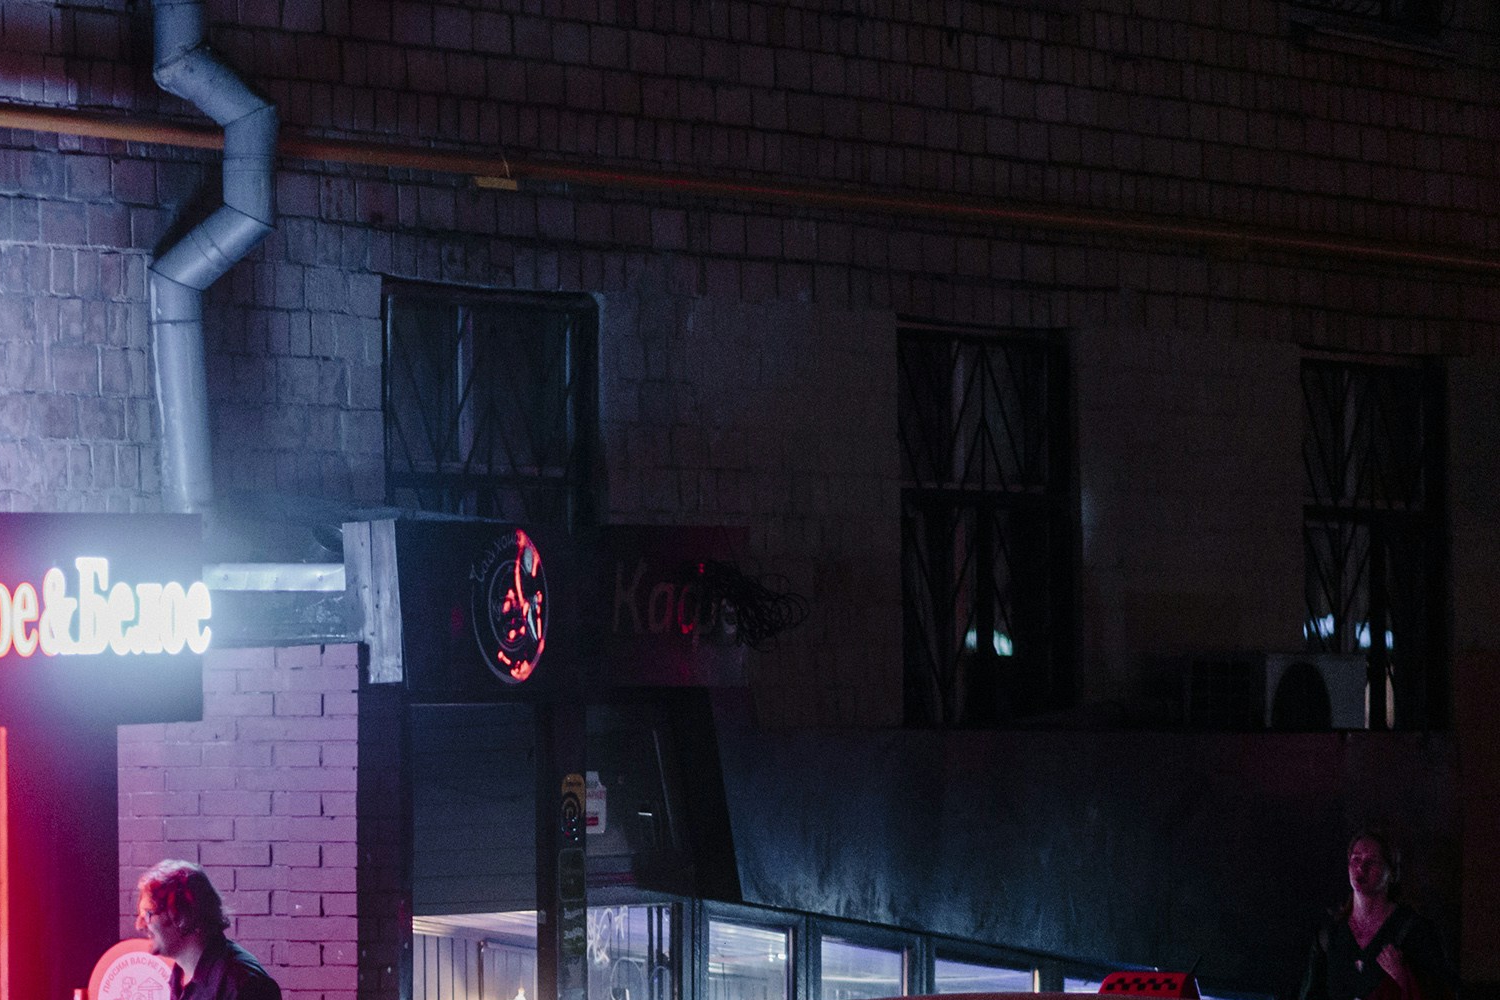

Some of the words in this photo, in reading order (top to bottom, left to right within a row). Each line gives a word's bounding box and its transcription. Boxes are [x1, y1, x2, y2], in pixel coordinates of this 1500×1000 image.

[103, 959, 129, 993] ПРОСИМ
[130, 957, 147, 966] ВАС
[147, 960, 159, 970] НЕ
